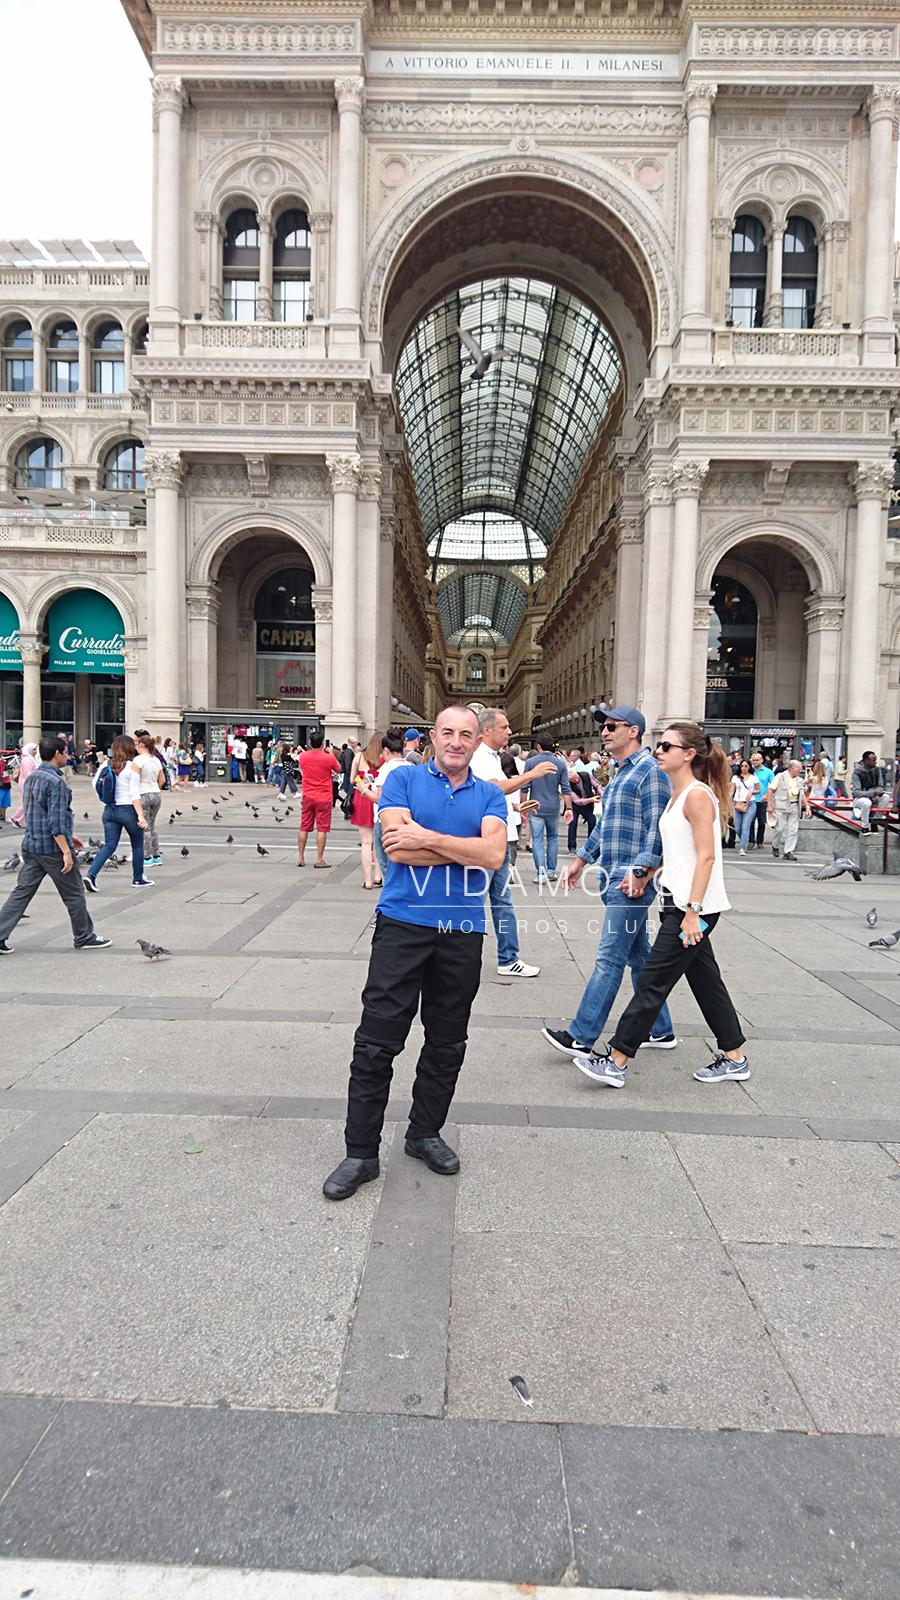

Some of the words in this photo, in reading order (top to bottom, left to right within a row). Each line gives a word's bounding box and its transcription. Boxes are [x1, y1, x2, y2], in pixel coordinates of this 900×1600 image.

[385, 58, 395, 67] A
[403, 57, 468, 69] VITTORIO
[476, 58, 553, 70] EMANUELE
[598, 59, 664, 71] MILANESI
[59, 627, 123, 653] Currado
[260, 629, 315, 646] CAMPA
[705, 677, 728, 687] otta
[280, 685, 312, 695] CAMPARI
